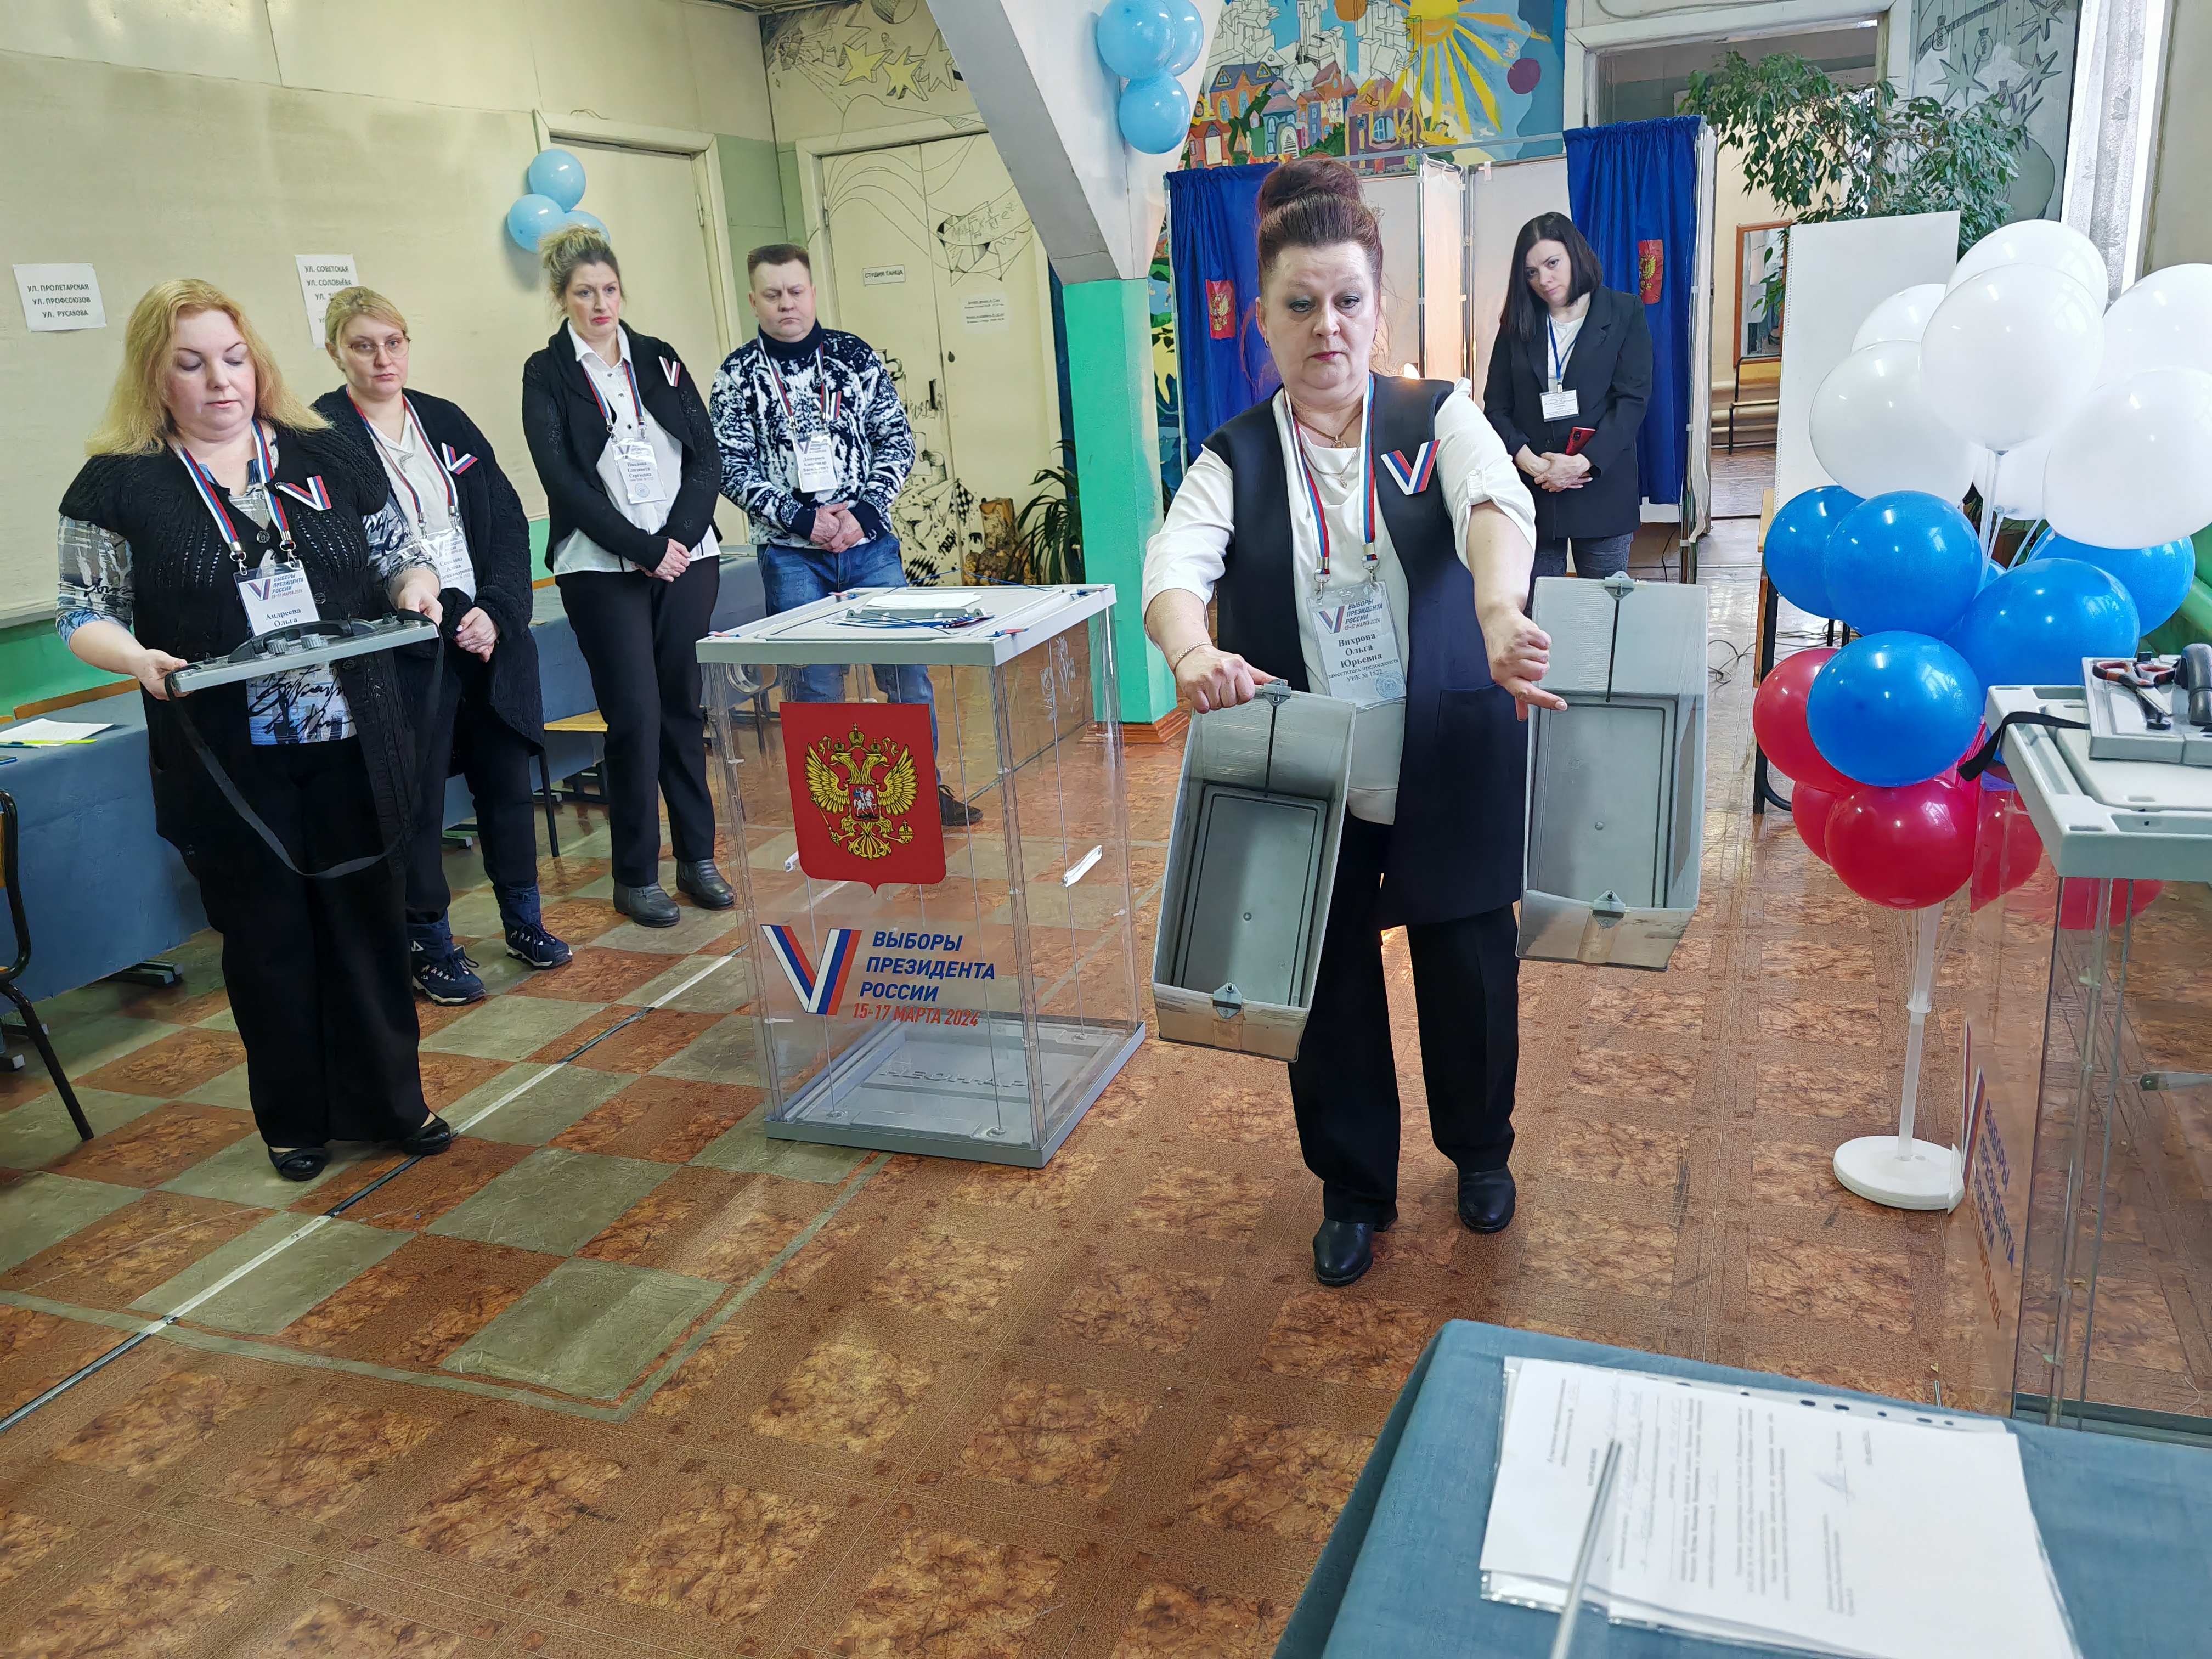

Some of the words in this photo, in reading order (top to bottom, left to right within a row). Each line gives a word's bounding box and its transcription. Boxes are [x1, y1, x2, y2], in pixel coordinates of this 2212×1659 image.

[273, 577, 304, 588] ПРЕЗИДЕНТА
[274, 573, 295, 582] ВЫБОРЫ
[272, 585, 292, 594] РОССИИ
[1346, 603, 1383, 617] ПРЕЗИДЕНТА
[1348, 599, 1373, 610] ВЫБОРЫ
[266, 608, 301, 620] Андреева
[1345, 614, 1368, 624] РОССИИ
[274, 618, 298, 627] Ольга
[1338, 633, 1376, 647] Вихрова
[1345, 645, 1373, 656] Ольга
[1340, 653, 1383, 668] Юрьевна
[1328, 668, 1361, 679] заместитель
[1370, 669, 1383, 677] 1522
[872, 931, 963, 952] ВЫБОРЫ
[866, 956, 996, 980] ПРЕЗИДЕНТА
[860, 981, 939, 1002] РОССИИ
[853, 1003, 890, 1020] 15-17
[892, 1006, 941, 1025] МАРТА
[944, 1008, 980, 1027] 2024
